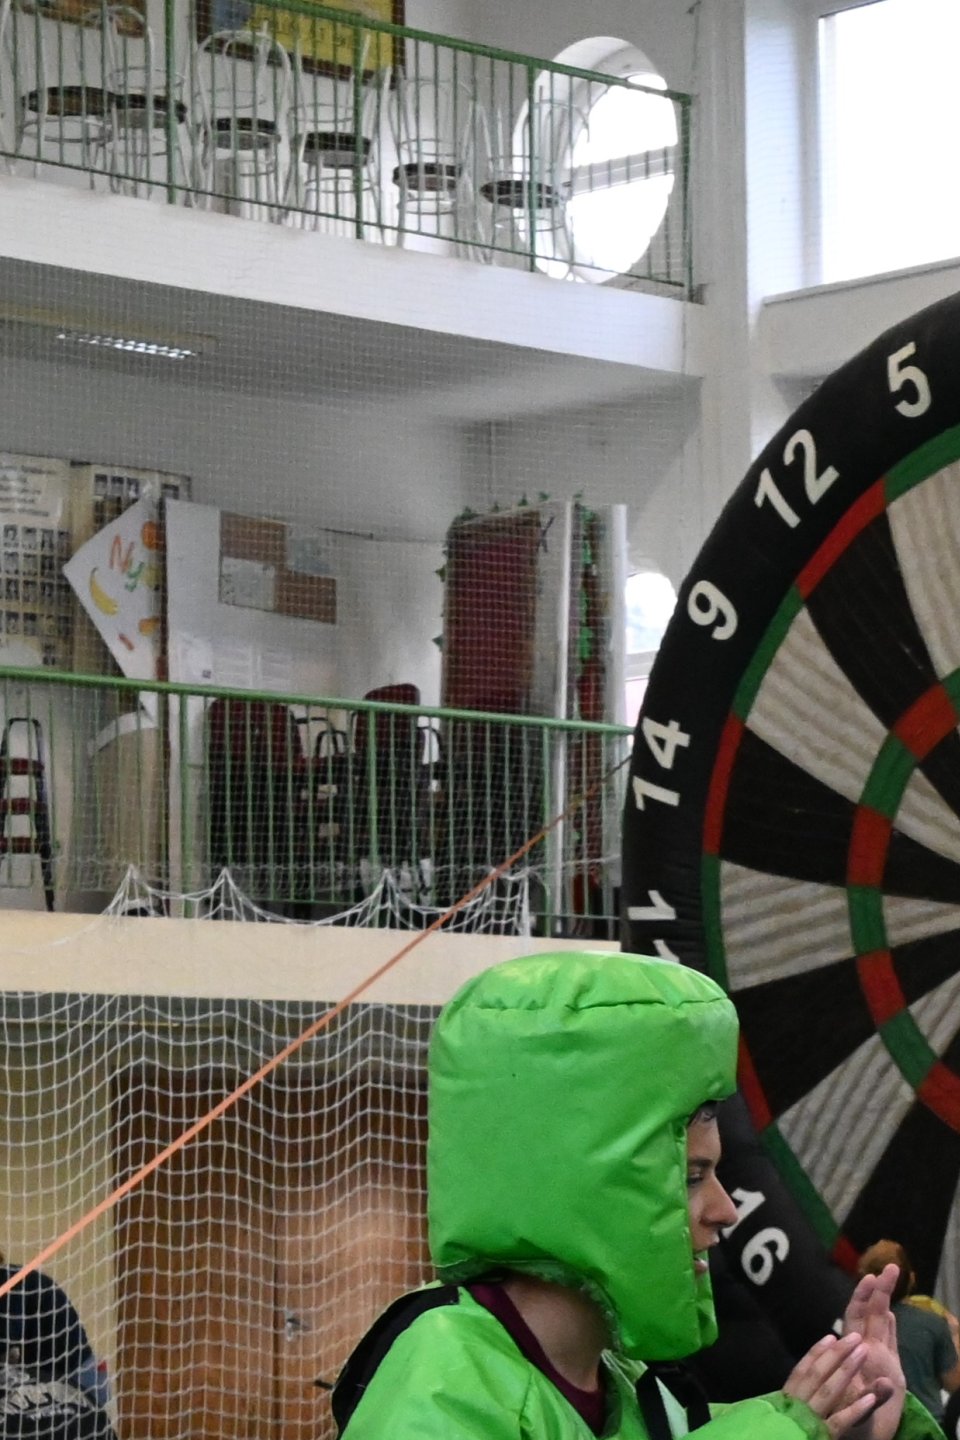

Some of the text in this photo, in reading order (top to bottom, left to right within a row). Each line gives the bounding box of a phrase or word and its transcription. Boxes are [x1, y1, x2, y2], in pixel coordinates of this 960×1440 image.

[887, 341, 932, 418] 5
[754, 429, 839, 528] 12
[687, 580, 738, 640] 9
[632, 716, 690, 811] 14
[720, 1187, 790, 1286] 16
